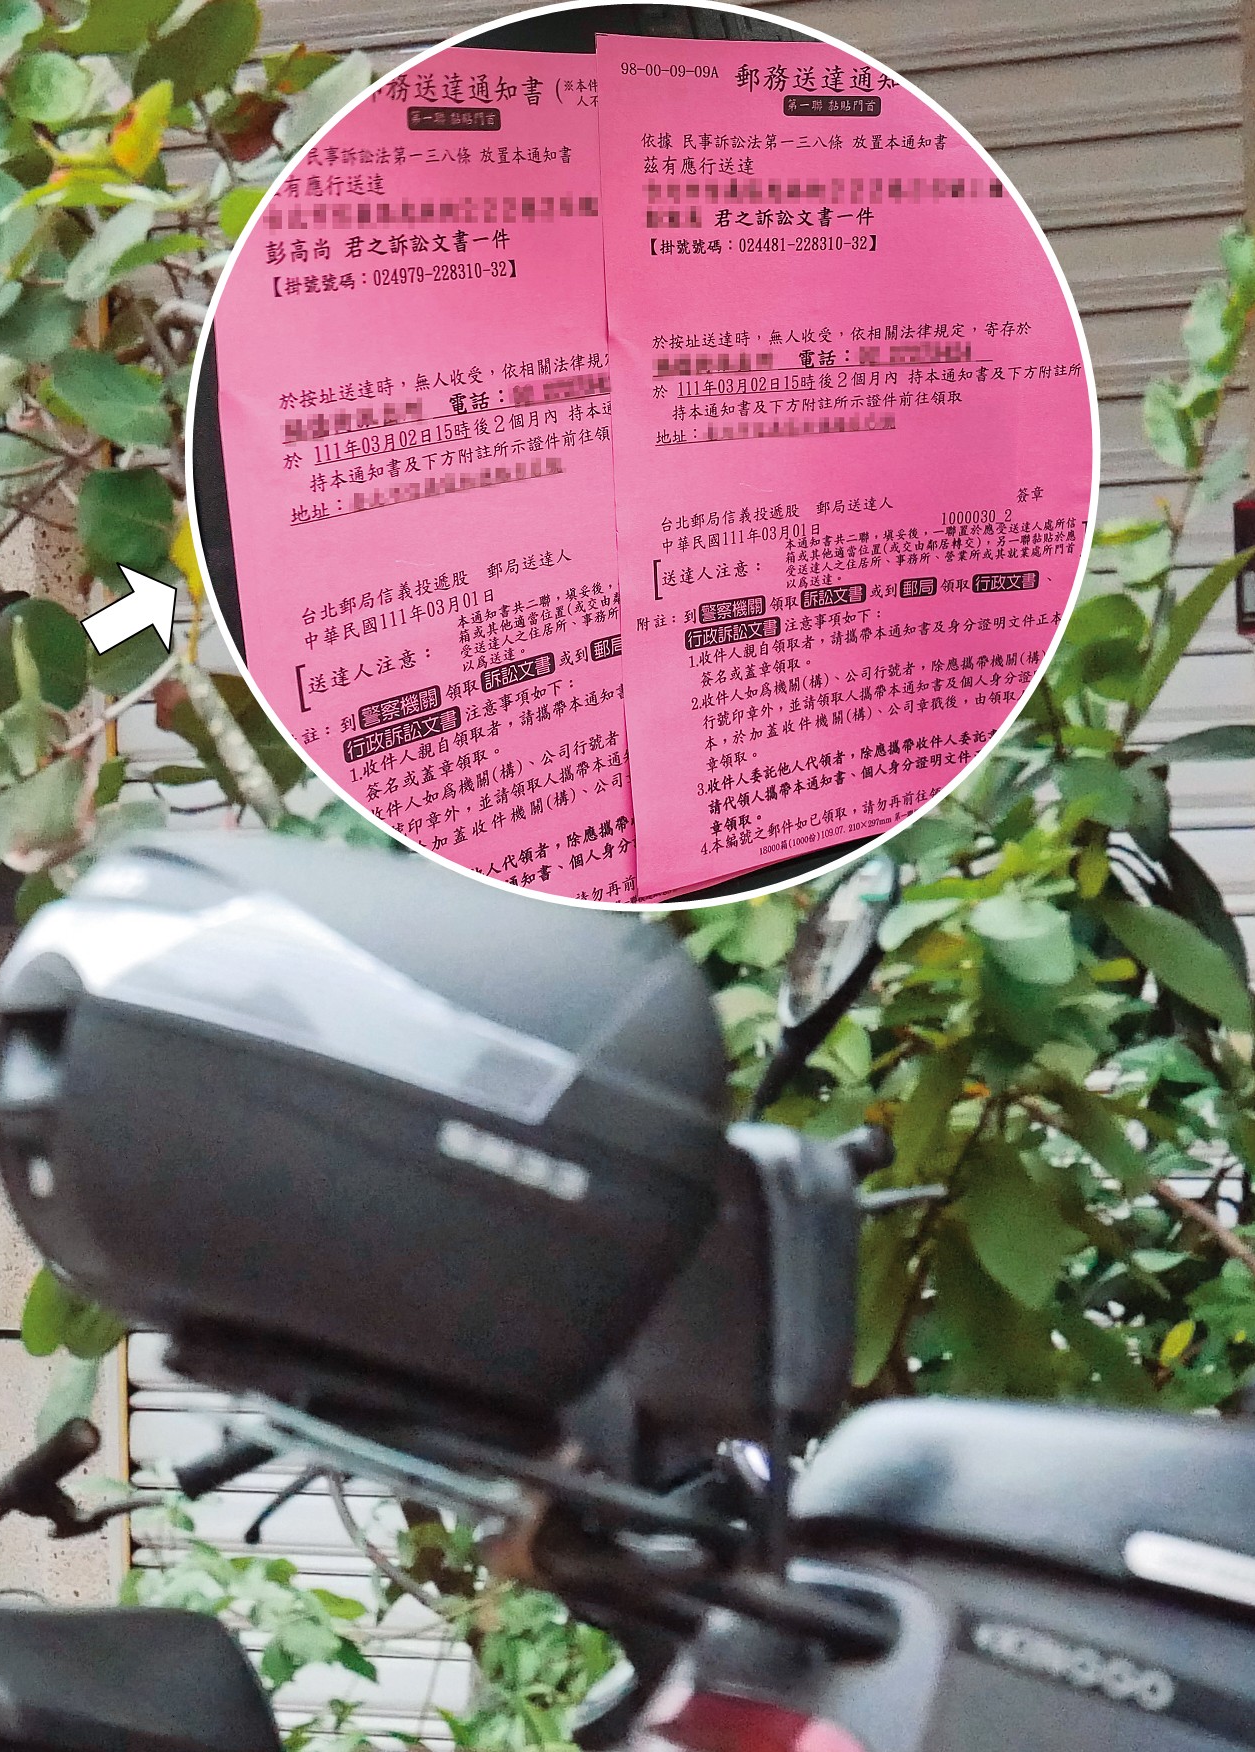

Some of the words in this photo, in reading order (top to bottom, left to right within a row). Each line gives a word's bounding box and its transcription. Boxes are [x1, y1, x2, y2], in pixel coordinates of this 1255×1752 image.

[620, 62, 719, 79] 98-00-09-09A
[372, 73, 544, 106] 務送達通知書
[787, 99, 822, 112] 第一聯
[828, 99, 876, 113] 黏貼門首
[479, 146, 572, 164] 放置本通知書
[641, 132, 673, 150] 依據
[682, 133, 843, 150] 民事訴訟法第一三八條
[852, 133, 948, 150] 放置本通知書
[274, 173, 386, 197] 有應行送達
[714, 207, 875, 228] 君之訴訟文書一件
[266, 238, 330, 265] 彭高尚
[344, 228, 510, 258] 君之訴訟文書一件
[278, 353, 609, 410] 於按址送達時，無人收受，依相關法律規
[908, 363, 1082, 385] 持本通知書及下方附註所
[672, 390, 962, 421] 持本通知書及下方附註所示證件前往領取
[1016, 486, 1044, 503] 簽章
[661, 503, 800, 532] 台北郵局信義投遞股
[816, 497, 894, 515] 郵局送達人
[301, 570, 470, 626] 台北郵局信義投遞股
[487, 550, 572, 579] 郵局送達人
[701, 597, 763, 622] 警察機關
[803, 585, 863, 608] 訴訟文書
[975, 573, 1036, 591] 行政文書
[687, 620, 778, 648] 行政訴訟文書
[361, 688, 438, 727] 警察機關
[483, 656, 551, 690] 訴訟文書
[703, 670, 1037, 730] 行號印章外，並請領取人攜帶本通知書及個人身分證
[347, 709, 457, 761] 行政訴訟文書
